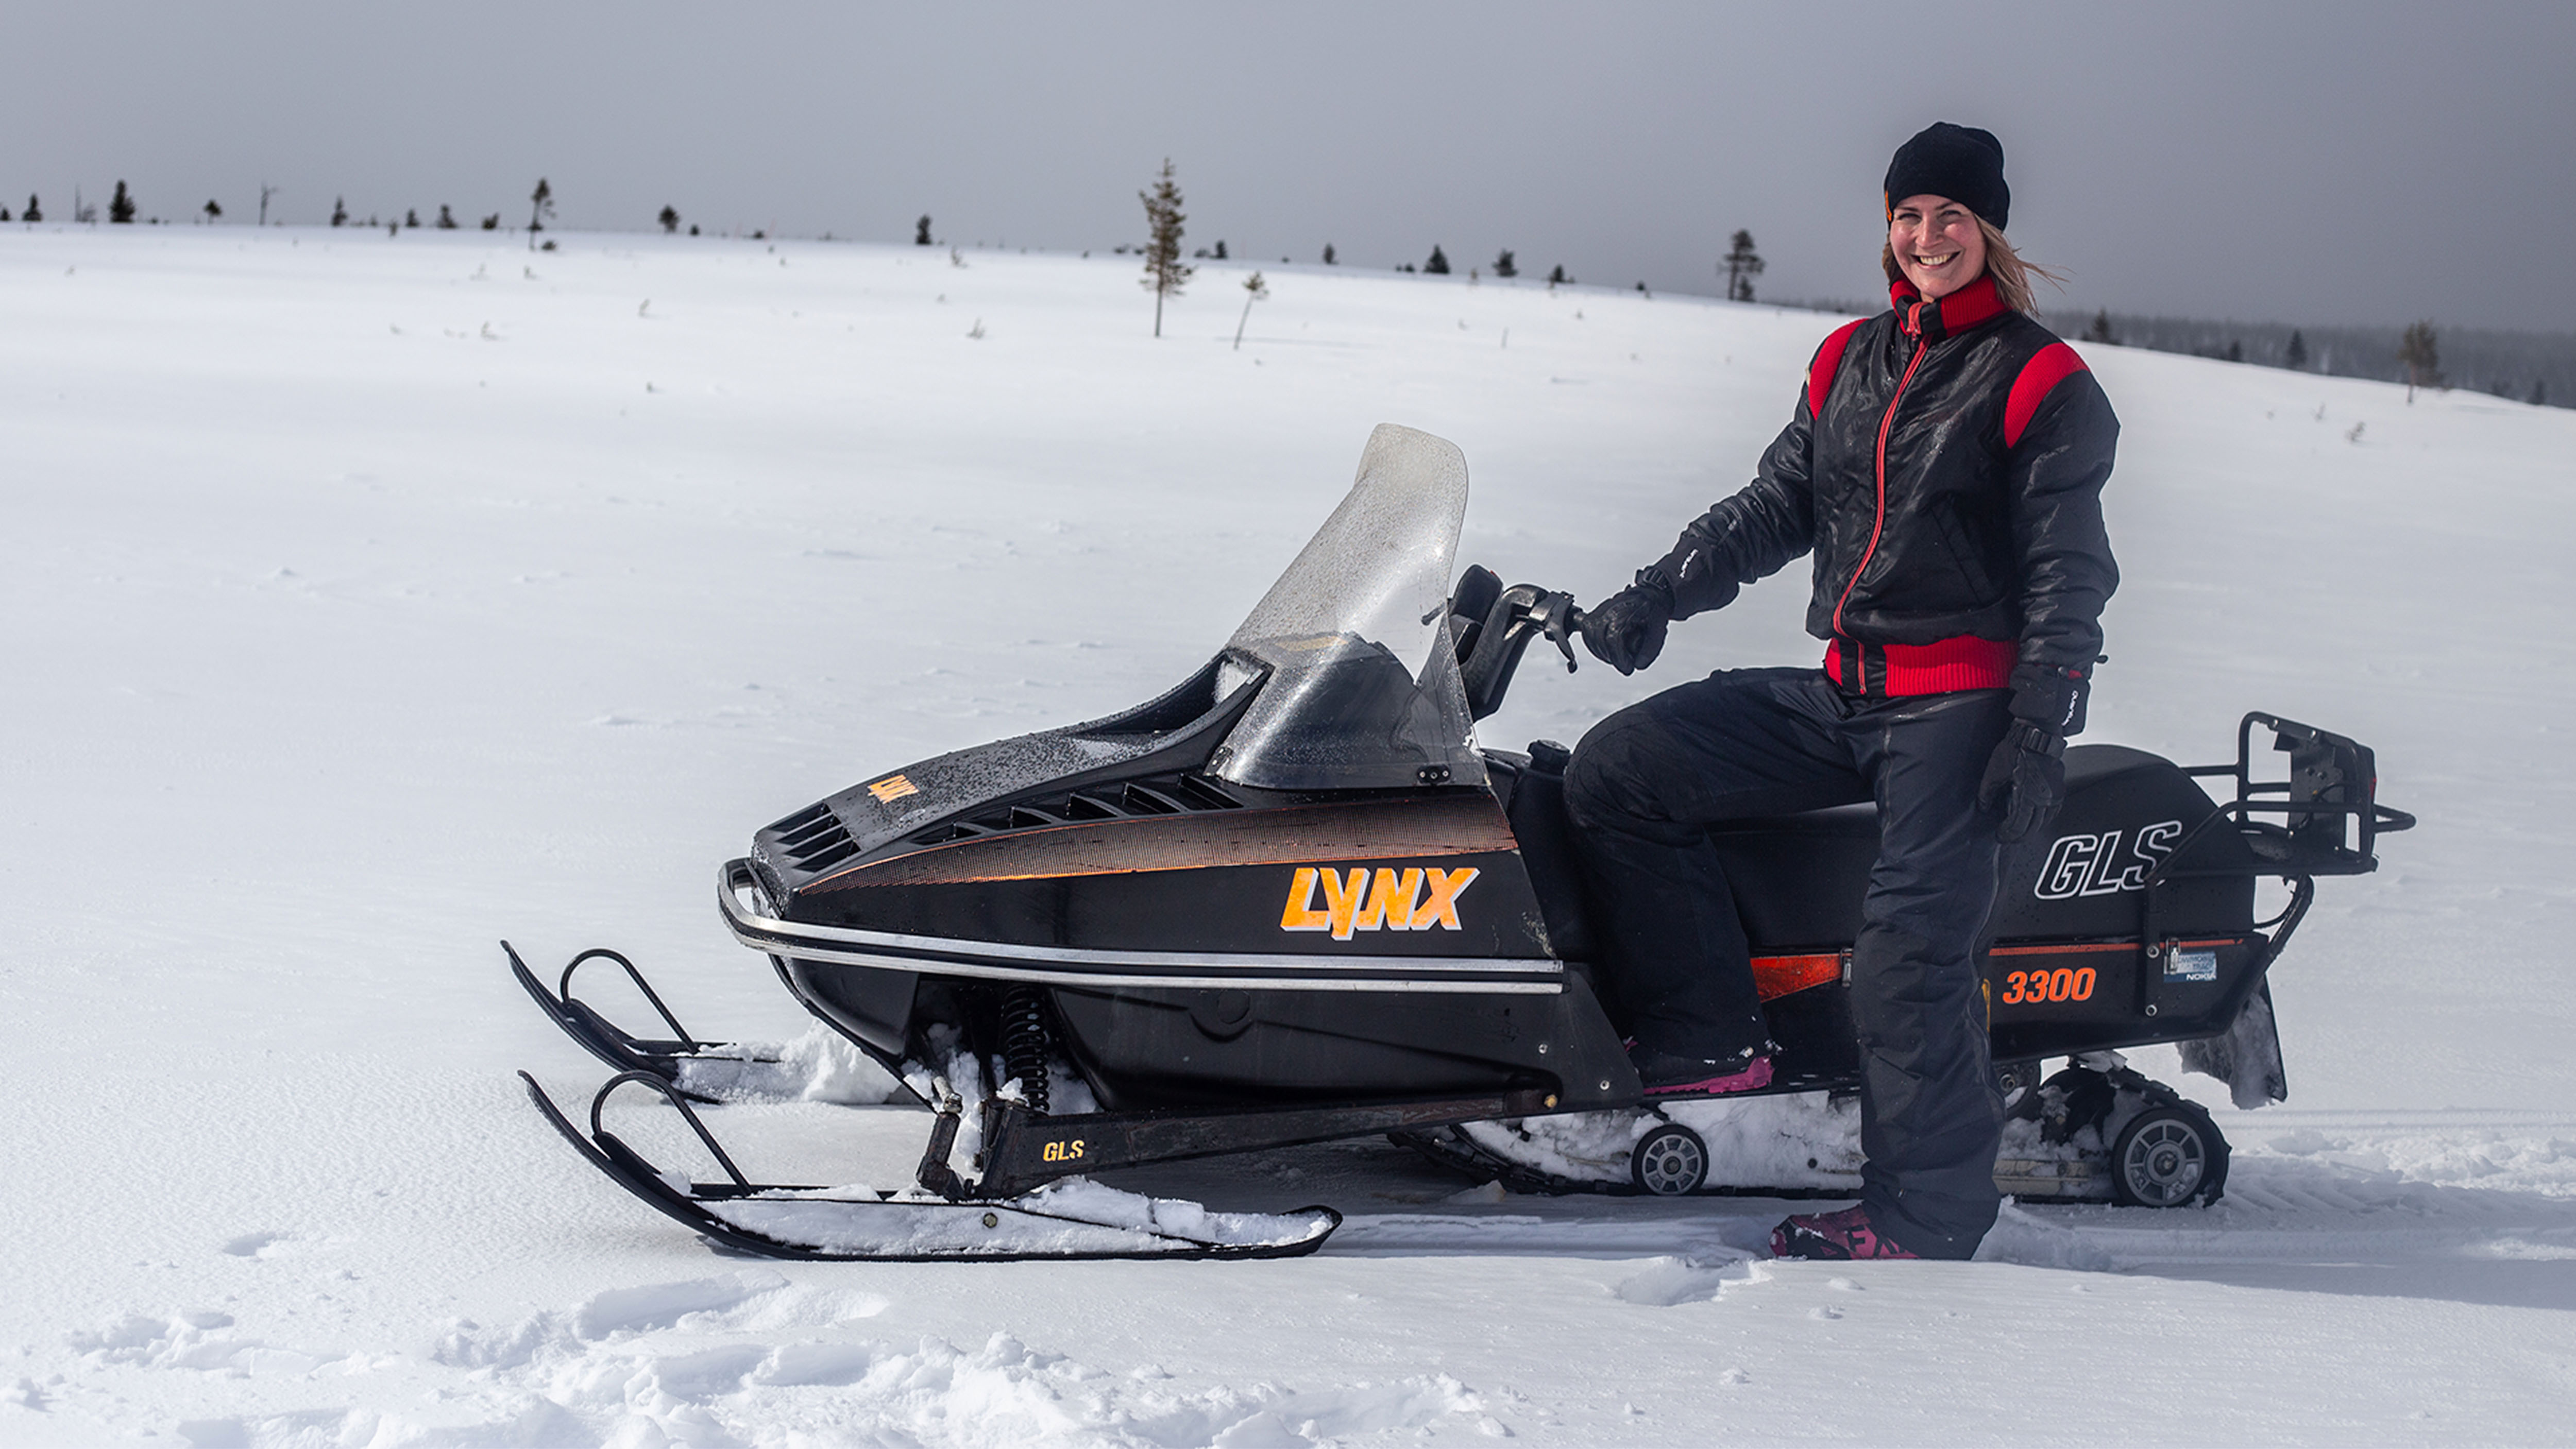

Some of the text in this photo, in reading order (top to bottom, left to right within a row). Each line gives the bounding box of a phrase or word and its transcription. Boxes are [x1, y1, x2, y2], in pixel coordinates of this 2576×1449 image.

[2034, 820, 2182, 899] GLS
[1280, 867, 1480, 941] LYNX
[2003, 967, 2096, 1003] 3300
[1043, 1139, 1084, 1162] GLS
